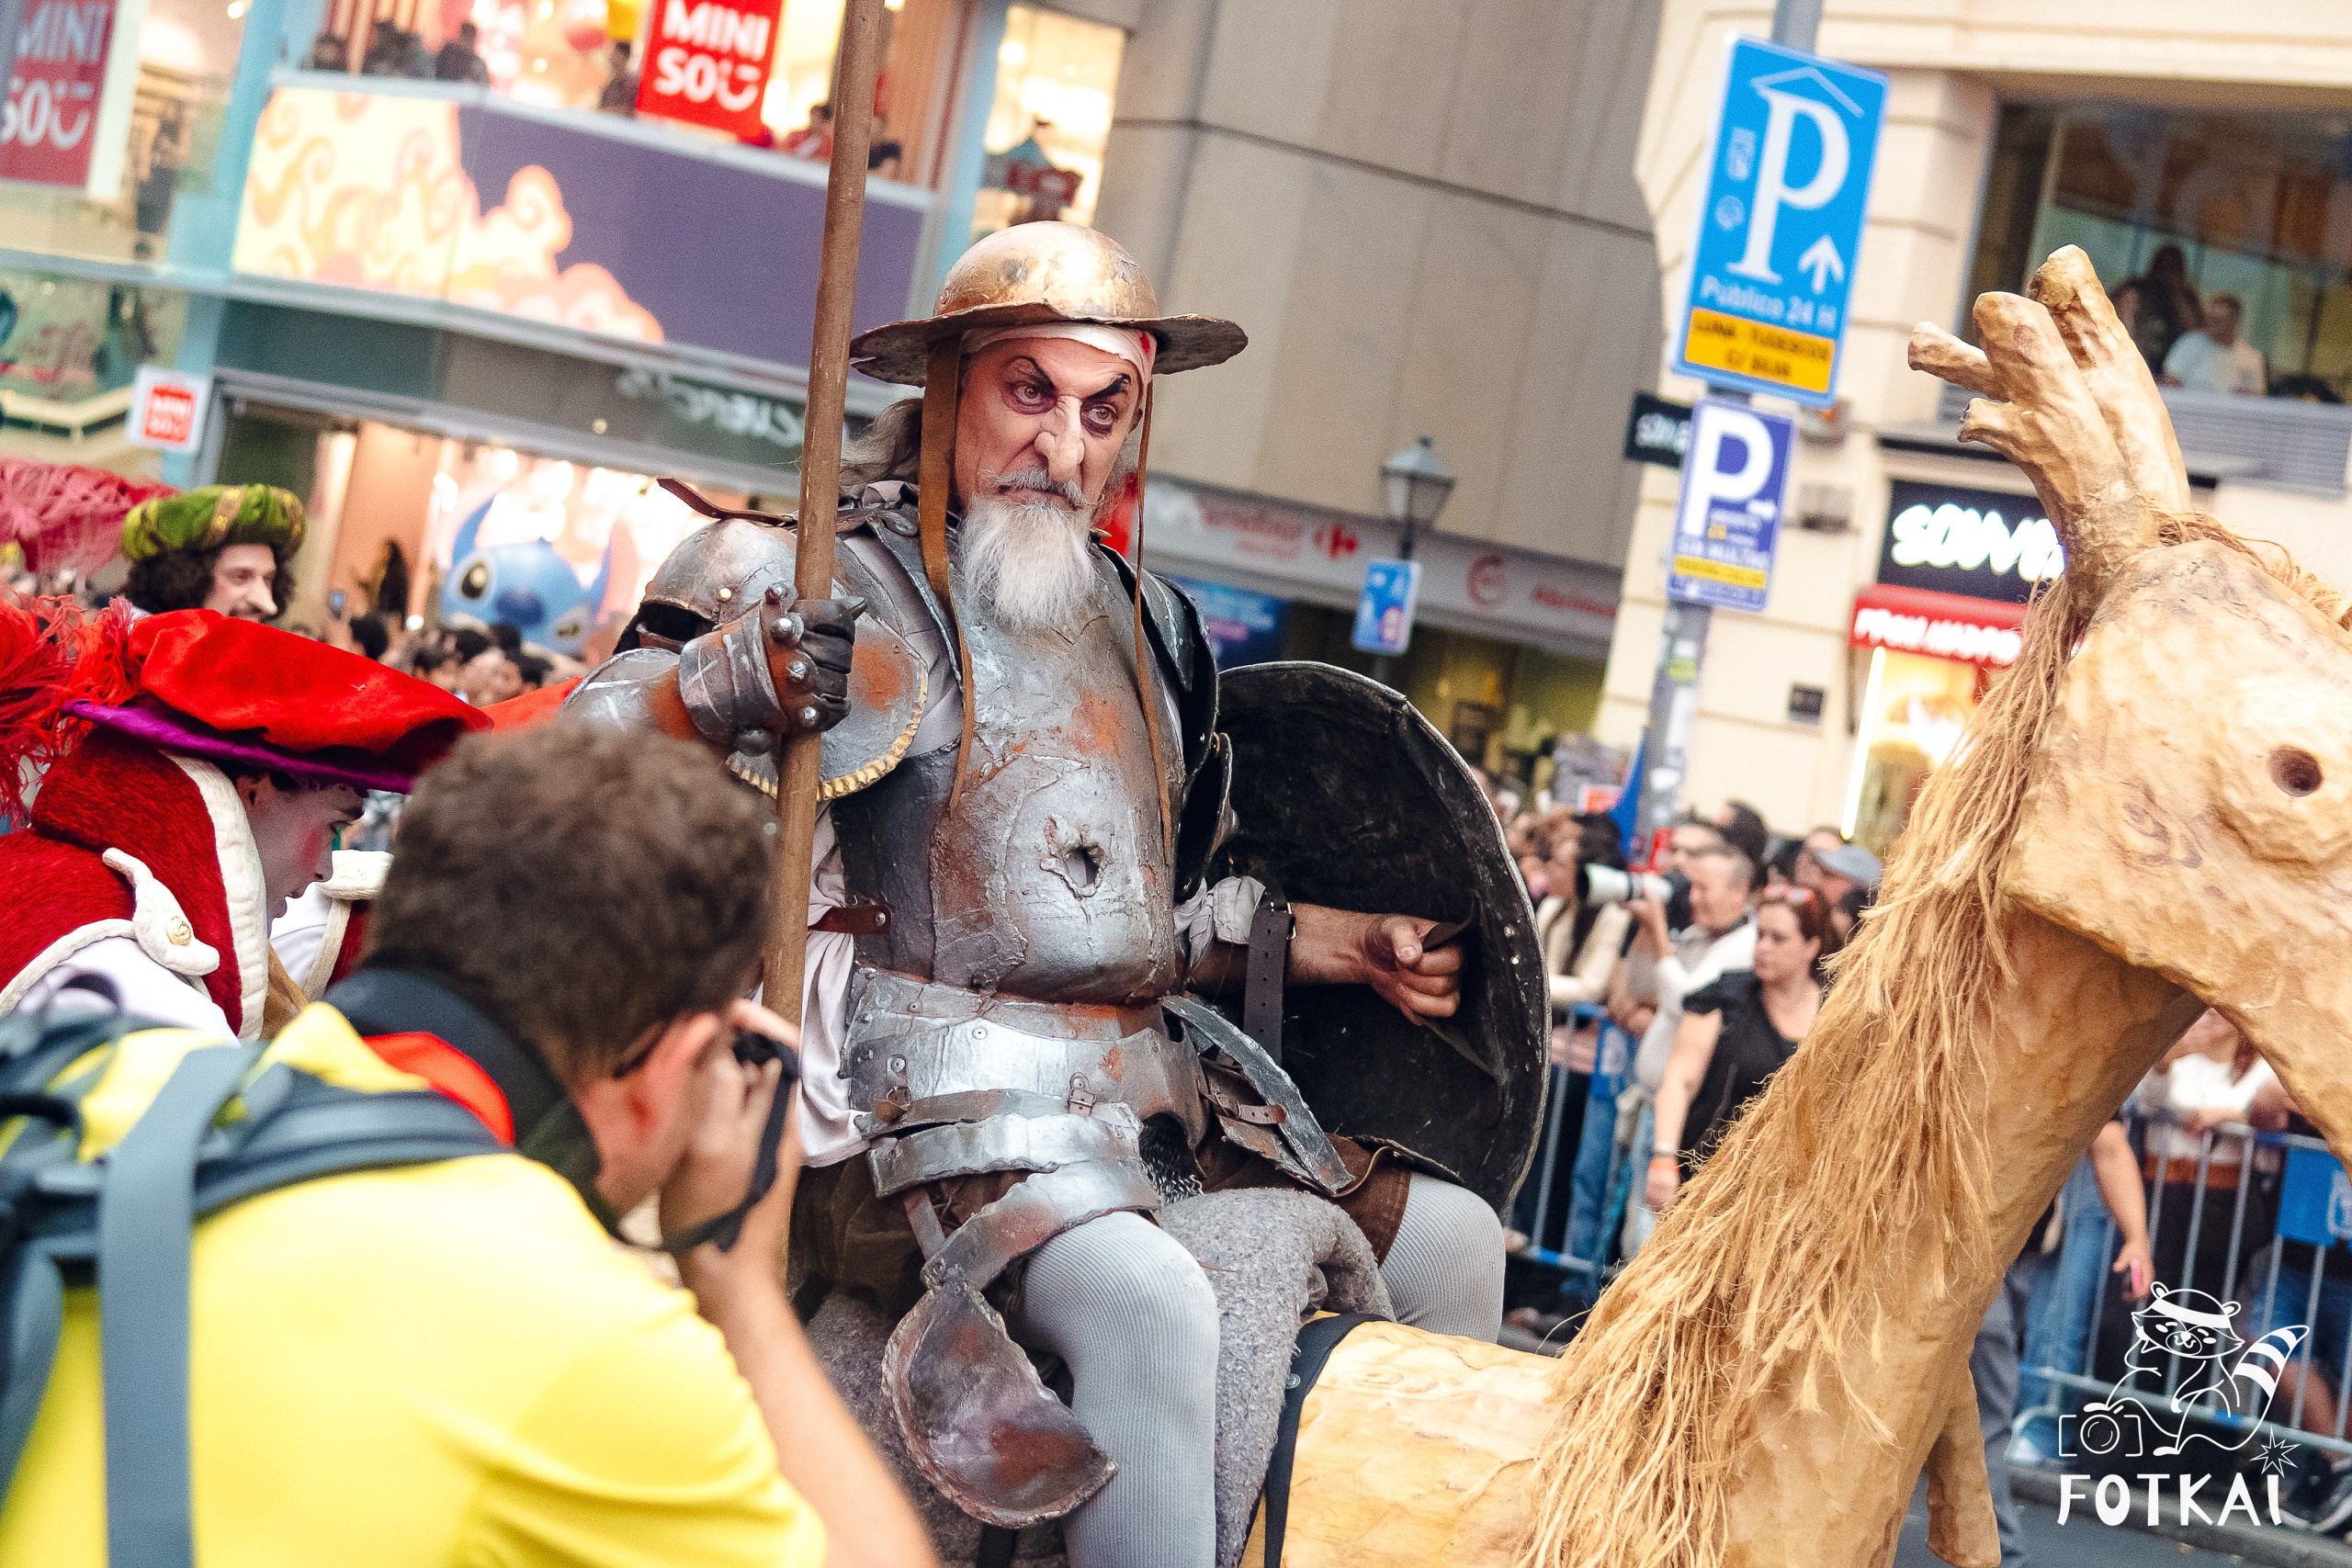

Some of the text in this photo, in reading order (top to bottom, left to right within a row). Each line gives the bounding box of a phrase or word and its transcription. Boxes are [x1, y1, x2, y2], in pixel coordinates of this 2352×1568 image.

[662, 0, 771, 62] MINI
[1726, 87, 1850, 283] P
[1682, 404, 1775, 536] P
